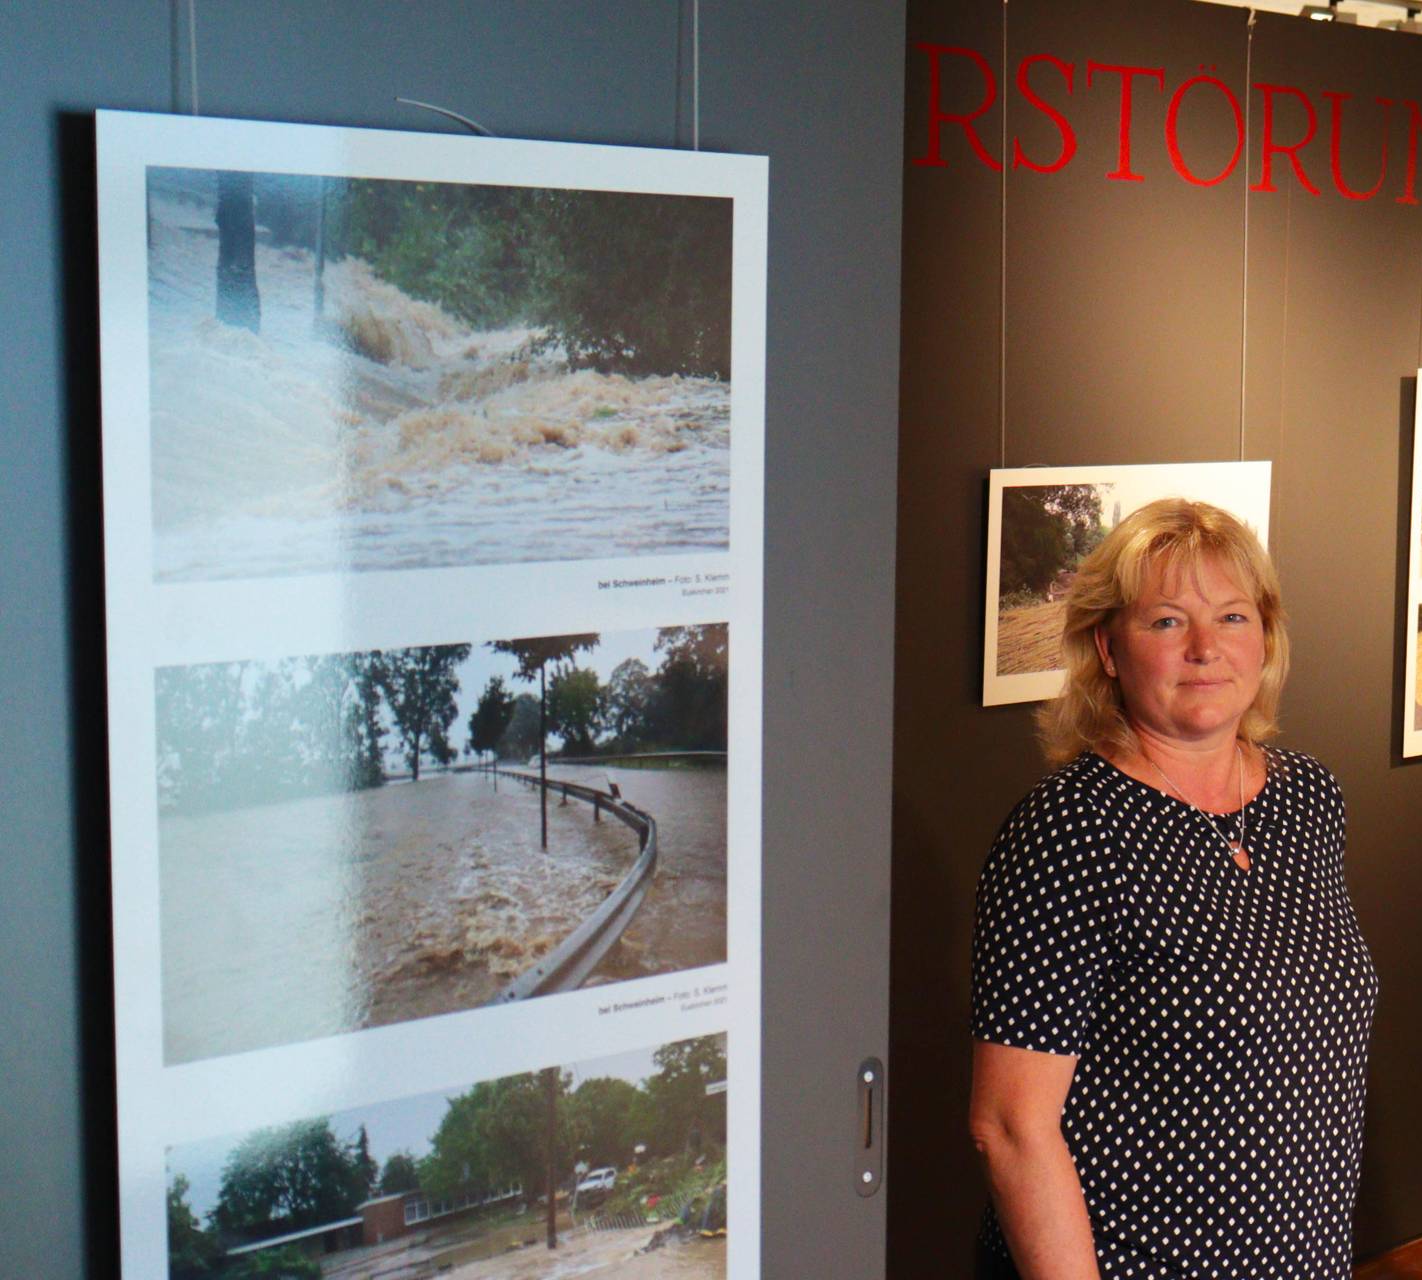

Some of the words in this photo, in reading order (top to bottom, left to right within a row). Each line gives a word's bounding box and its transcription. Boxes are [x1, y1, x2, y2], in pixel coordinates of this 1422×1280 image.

[598, 580, 610, 590] bei
[613, 578, 665, 588] Schweinheim
[613, 996, 665, 1012] Schweinheim
